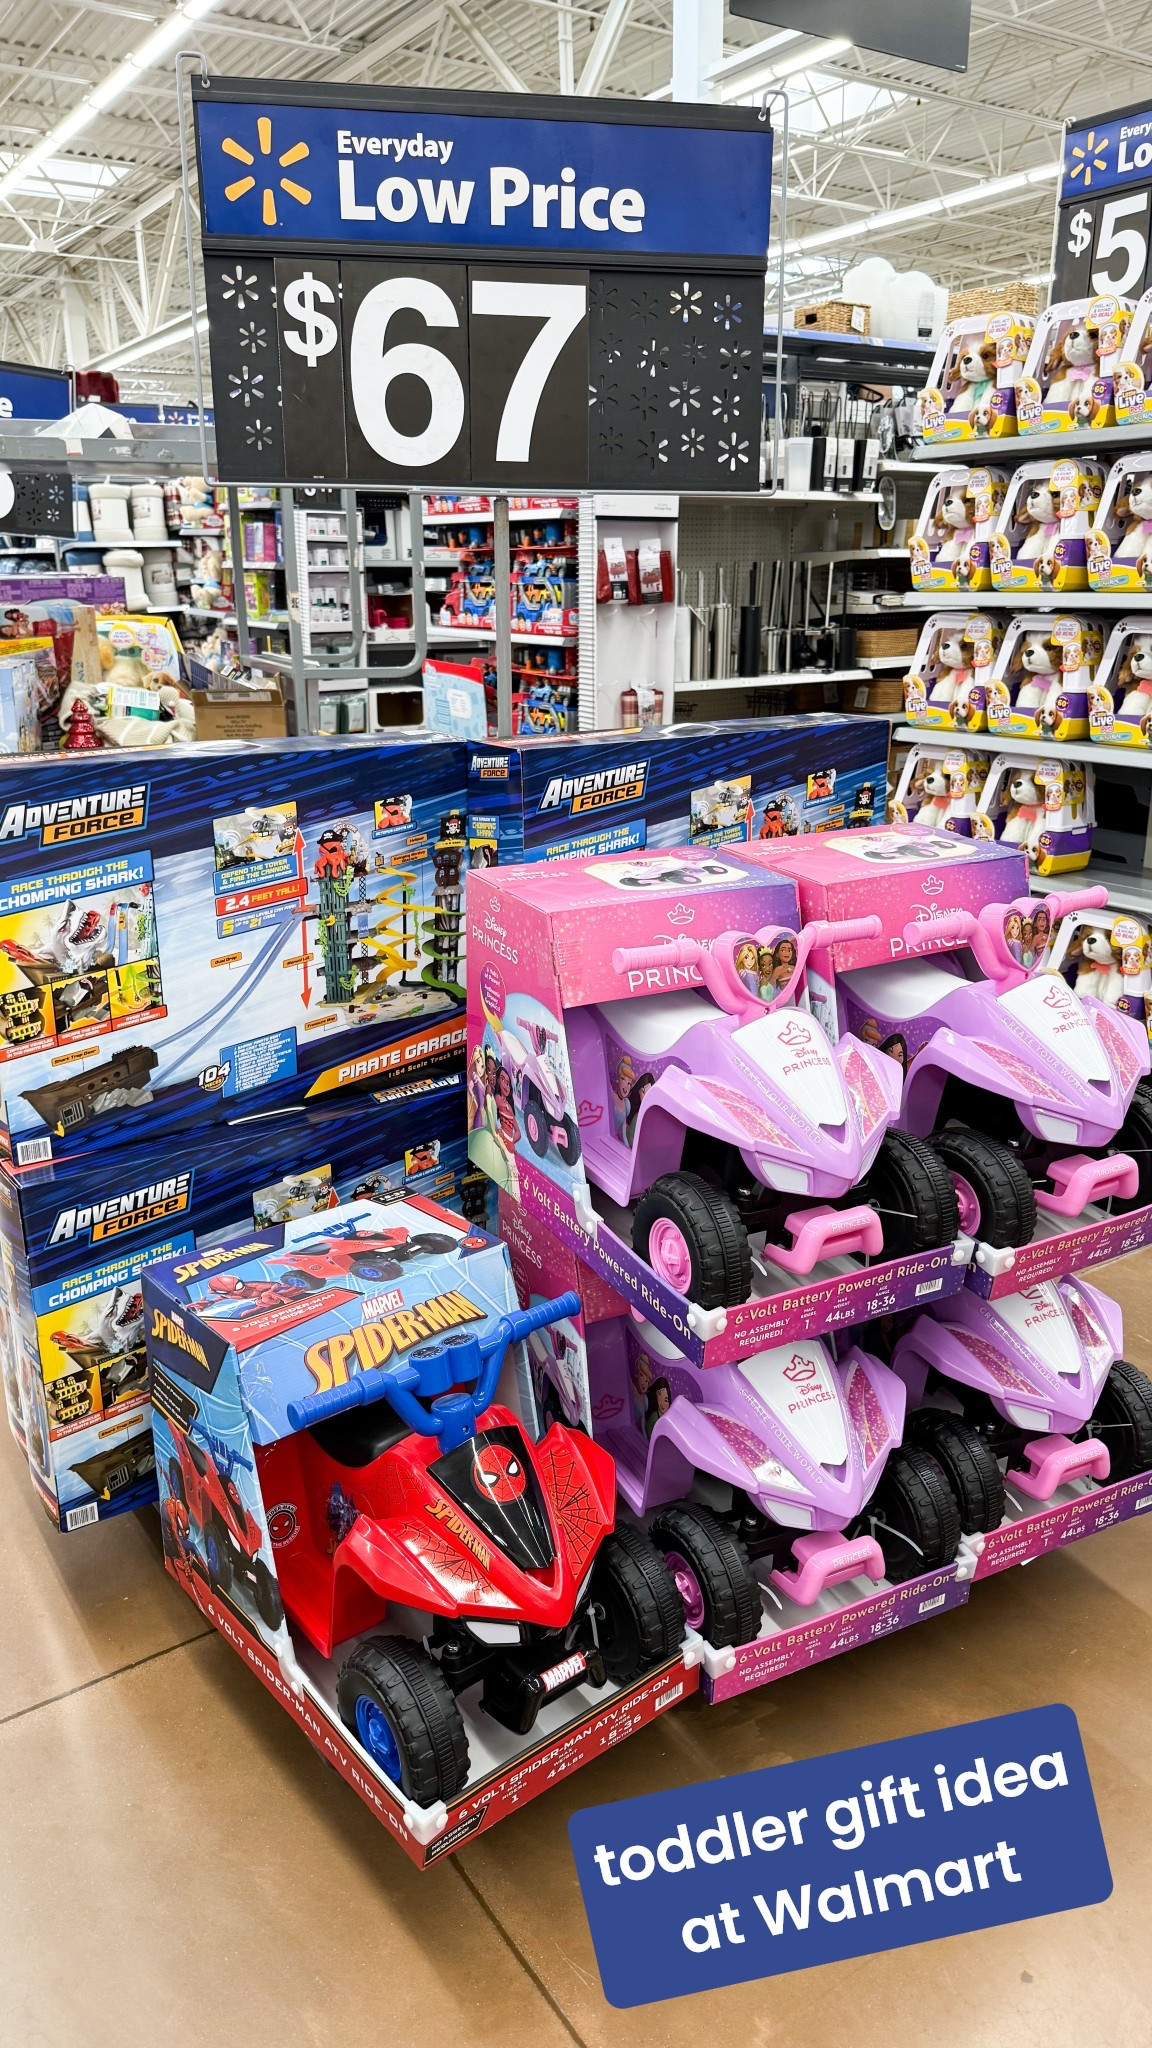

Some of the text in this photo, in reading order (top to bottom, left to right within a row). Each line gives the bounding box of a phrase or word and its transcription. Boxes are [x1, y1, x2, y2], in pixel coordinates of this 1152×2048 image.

[1120, 119, 1152, 140] Every
[337, 130, 454, 165] Everyday
[1117, 139, 1152, 173] Lo
[338, 159, 646, 233] Low Price
[283, 272, 588, 467] $67
[1118, 391, 1144, 408] Live
[925, 414, 945, 429] Live
[1020, 405, 1042, 420] Live
[913, 562, 931, 575] Live
[993, 561, 1011, 574] Live
[1090, 559, 1111, 572] Live
[908, 702, 926, 712] Live
[990, 708, 1009, 719] Live
[1092, 715, 1113, 726] Live
[471, 755, 508, 771] ADVENTURE
[540, 761, 647, 809] ADVENTURE
[580, 785, 637, 809] FORCE
[0, 785, 146, 839] ADVENTURE
[53, 812, 135, 840] FORCE
[547, 827, 629, 855] RACE THROUGH THE
[598, 833, 640, 854] SHARK!
[11, 860, 128, 894] RACE THROUGH THE
[85, 866, 143, 890] SHARK!
[221, 868, 248, 879] DEFEND
[225, 884, 300, 911] 2.4 FEET TALL!
[222, 919, 234, 935] 5
[484, 911, 507, 938] Disney
[472, 925, 518, 964] PRINCESS
[628, 966, 703, 992] PRINC
[1003, 1017, 1033, 1046] CREATE
[1035, 1046, 1060, 1072] YOUR
[199, 1061, 230, 1086] 104
[338, 1050, 401, 1082] PIRATE
[388, 1068, 405, 1078] 1:64
[408, 1061, 428, 1072] Scale
[431, 1054, 451, 1064] Track
[783, 1057, 831, 1076] PRINCESS
[790, 1111, 822, 1145] WORLD
[50, 1173, 189, 1244] ADVENTURE
[102, 1198, 178, 1235] FORCE
[511, 1211, 532, 1244] Disney
[831, 1216, 871, 1231] PRINCESS
[502, 1220, 542, 1269] PRINCESS
[1019, 1245, 1054, 1264] 6-Volt
[1057, 1231, 1100, 1252] Battery
[1102, 1212, 1149, 1237] Powered
[1121, 1234, 1145, 1248] 18-36
[532, 1183, 550, 1209] Volt
[554, 1203, 590, 1246] Battery
[593, 1236, 637, 1290] Powered
[642, 1285, 691, 1340] Ride-On
[1027, 1257, 1061, 1272] ASSEMBLY
[1087, 1247, 1112, 1259] 44LBS
[62, 1242, 172, 1290] RACE THROUGH THE
[1018, 1266, 1054, 1282] REQUIRED!
[48, 1270, 128, 1307] CHOMPING
[735, 1257, 948, 1324] 6-Volt Battery Powered Ride-On
[242, 1293, 336, 1328] VOLT SPIDER-MAN
[258, 1303, 324, 1328] ATV RIDE-ON
[361, 1289, 404, 1320] MARVEL
[825, 1308, 855, 1323] 44LBS
[866, 1295, 896, 1312] 18-36
[734, 1318, 790, 1339] NO ASSEMBLY
[805, 1319, 809, 1329] 1
[304, 1290, 488, 1398] SPIDER-MAN
[739, 1329, 783, 1347] REQUIRED!
[1033, 1359, 1061, 1391] WORLD
[796, 1383, 822, 1395] Disney
[793, 1451, 823, 1484] WORLD
[988, 1490, 1118, 1550] 6-Volt Battery Powered
[1095, 1511, 1119, 1526] 18-36
[424, 1498, 491, 1573] SPIDER-MAN
[1061, 1526, 1085, 1539] 44LBS
[991, 1548, 1027, 1566] REQUIRED!
[999, 1539, 1033, 1556] ASSEMBLY
[739, 1575, 950, 1664] 6-Volt Battery Powered Ride-On
[871, 1615, 900, 1633] 18-36
[830, 1634, 859, 1650] 44LBS
[739, 1651, 795, 1676] NO ASSEMBLY
[809, 1650, 814, 1659] 1
[542, 1652, 586, 1692] MARVEL
[745, 1661, 788, 1682] REQUIRED!
[217, 1613, 245, 1649] VOLT
[247, 1647, 321, 1734] SPIDER-MAN
[324, 1736, 347, 1767] ATV
[352, 1768, 408, 1841] RIDE-ON
[599, 1714, 642, 1746] 18-36
[610, 1714, 631, 1730] RANGE
[458, 1676, 670, 1819] 6 VOLT SPIDER-MAN ATV RIDE-ON
[607, 1728, 633, 1746] MONTHS
[553, 1748, 578, 1767] WEIGHT
[559, 1748, 573, 1759] MAX
[547, 1753, 584, 1779] 44LBS
[502, 1782, 527, 1800] RIDERS
[507, 1780, 522, 1792] MAX
[431, 1813, 481, 1851] NO ASSEMBLY
[431, 1826, 470, 1856] REQUIRED!
